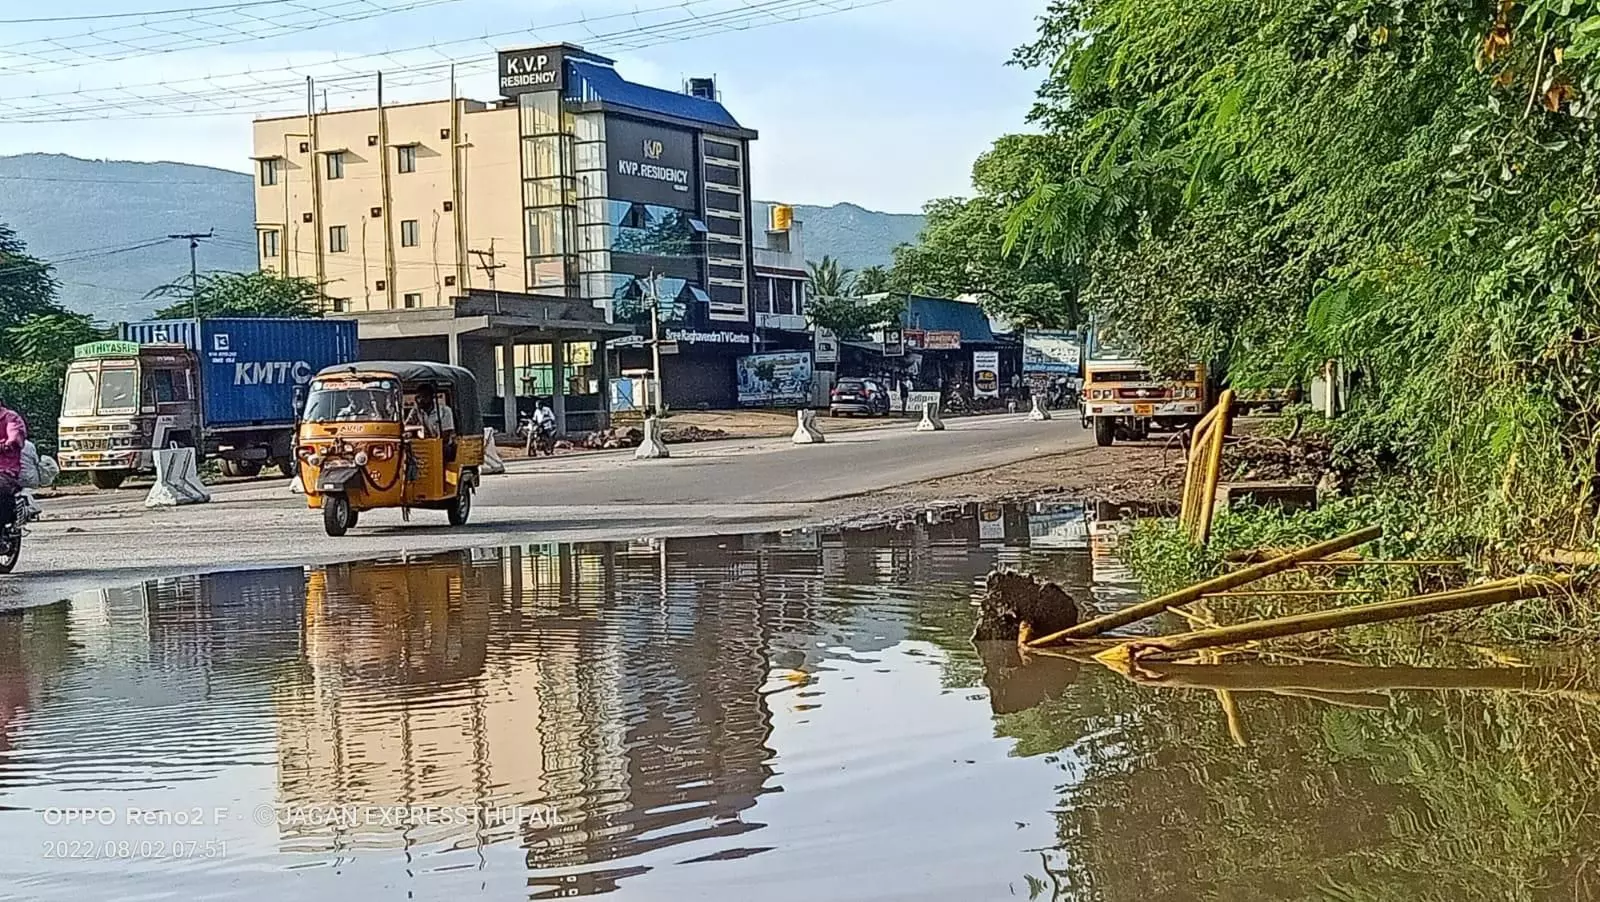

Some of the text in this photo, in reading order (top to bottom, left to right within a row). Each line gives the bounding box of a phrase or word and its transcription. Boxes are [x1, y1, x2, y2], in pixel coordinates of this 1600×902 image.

[507, 55, 549, 75] K.V.P
[501, 70, 556, 88] RESIDENCY
[643, 139, 663, 159] KVP
[665, 328, 681, 341] Sree
[681, 329, 720, 344] Raghavendra
[234, 360, 311, 385] KMTC
